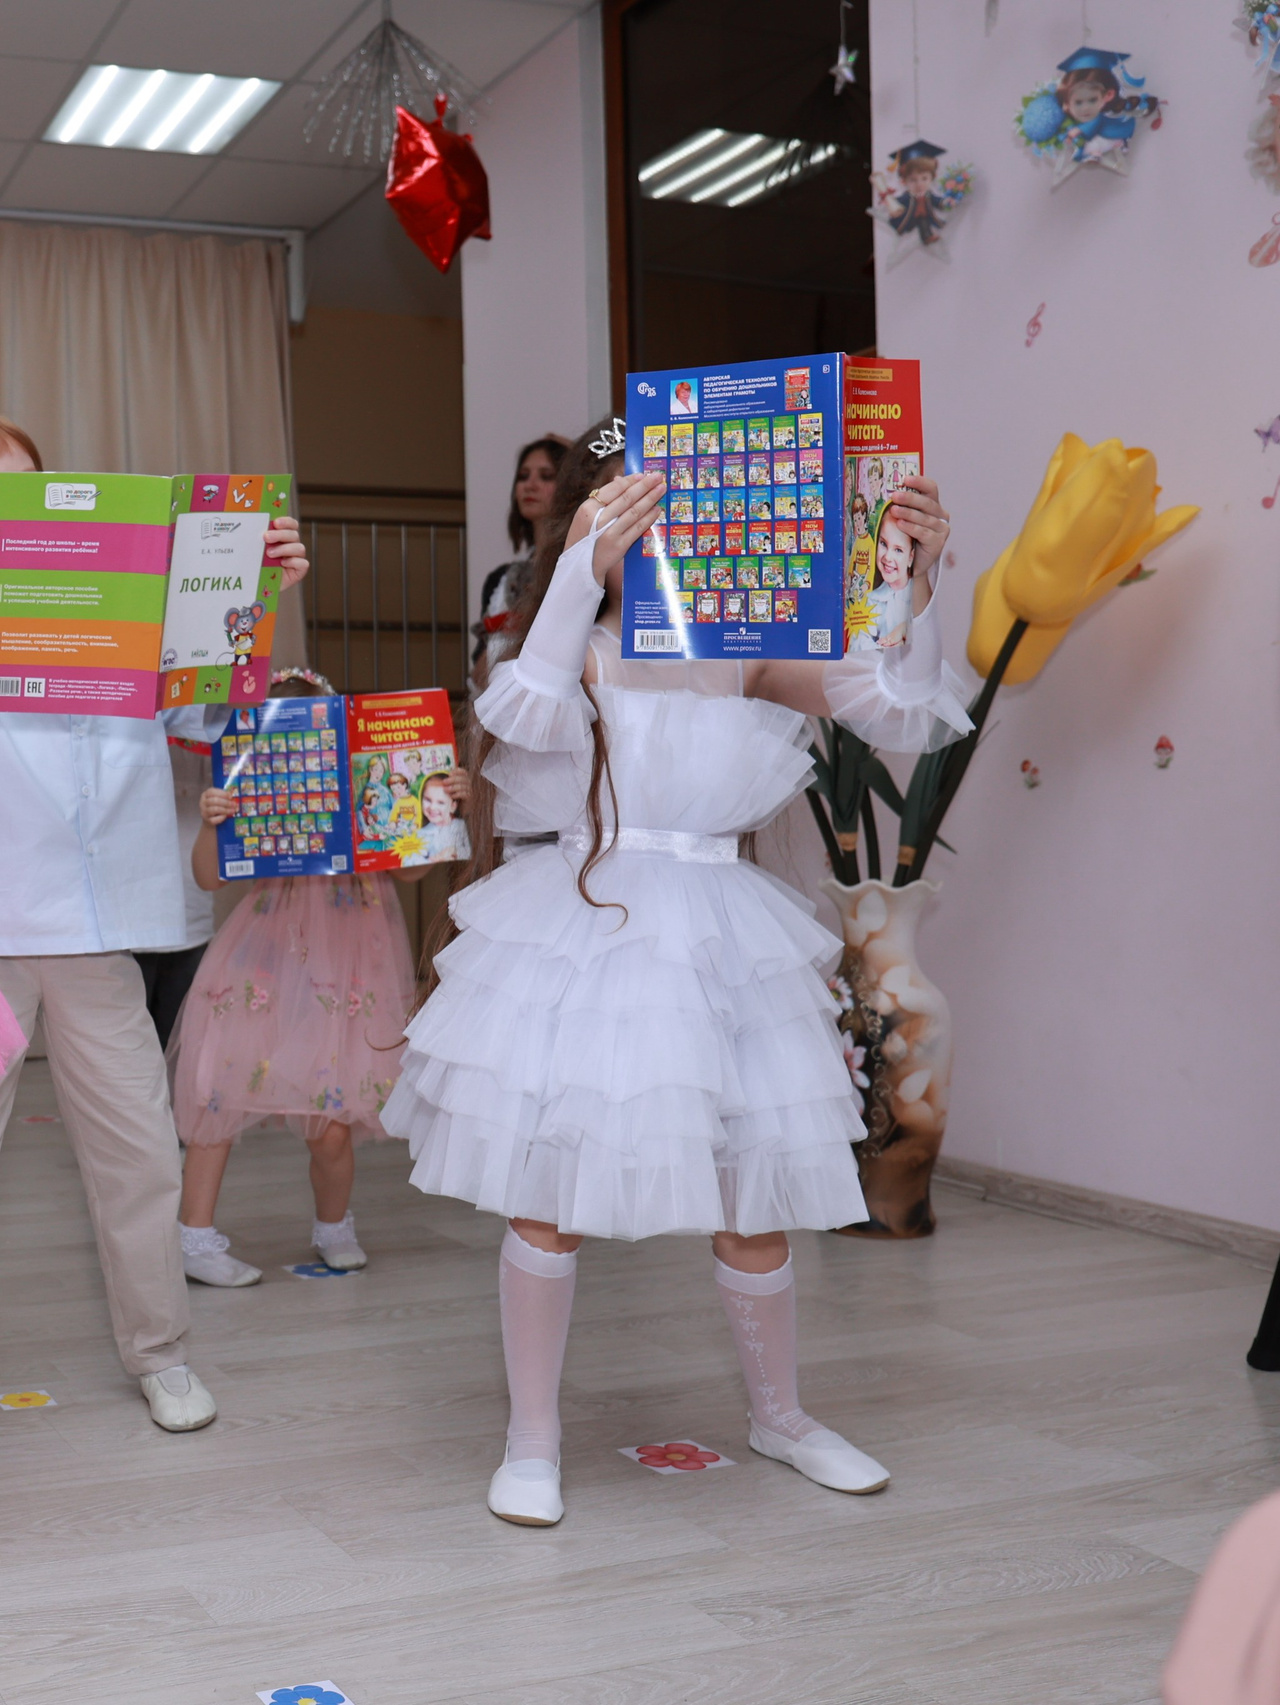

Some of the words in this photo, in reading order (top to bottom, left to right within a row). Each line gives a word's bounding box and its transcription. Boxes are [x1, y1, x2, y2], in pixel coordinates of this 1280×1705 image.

[703, 379, 744, 387] ПЕДАГОГИЧЕСКАЯ
[738, 381, 777, 390] ДОШКОЛЬНИКОВ
[846, 402, 901, 419] начинаю
[847, 424, 884, 440] читать
[179, 576, 242, 592] ЛОГИКА
[357, 718, 364, 732] Я
[366, 715, 434, 731] начинаю
[370, 729, 419, 743] читать
